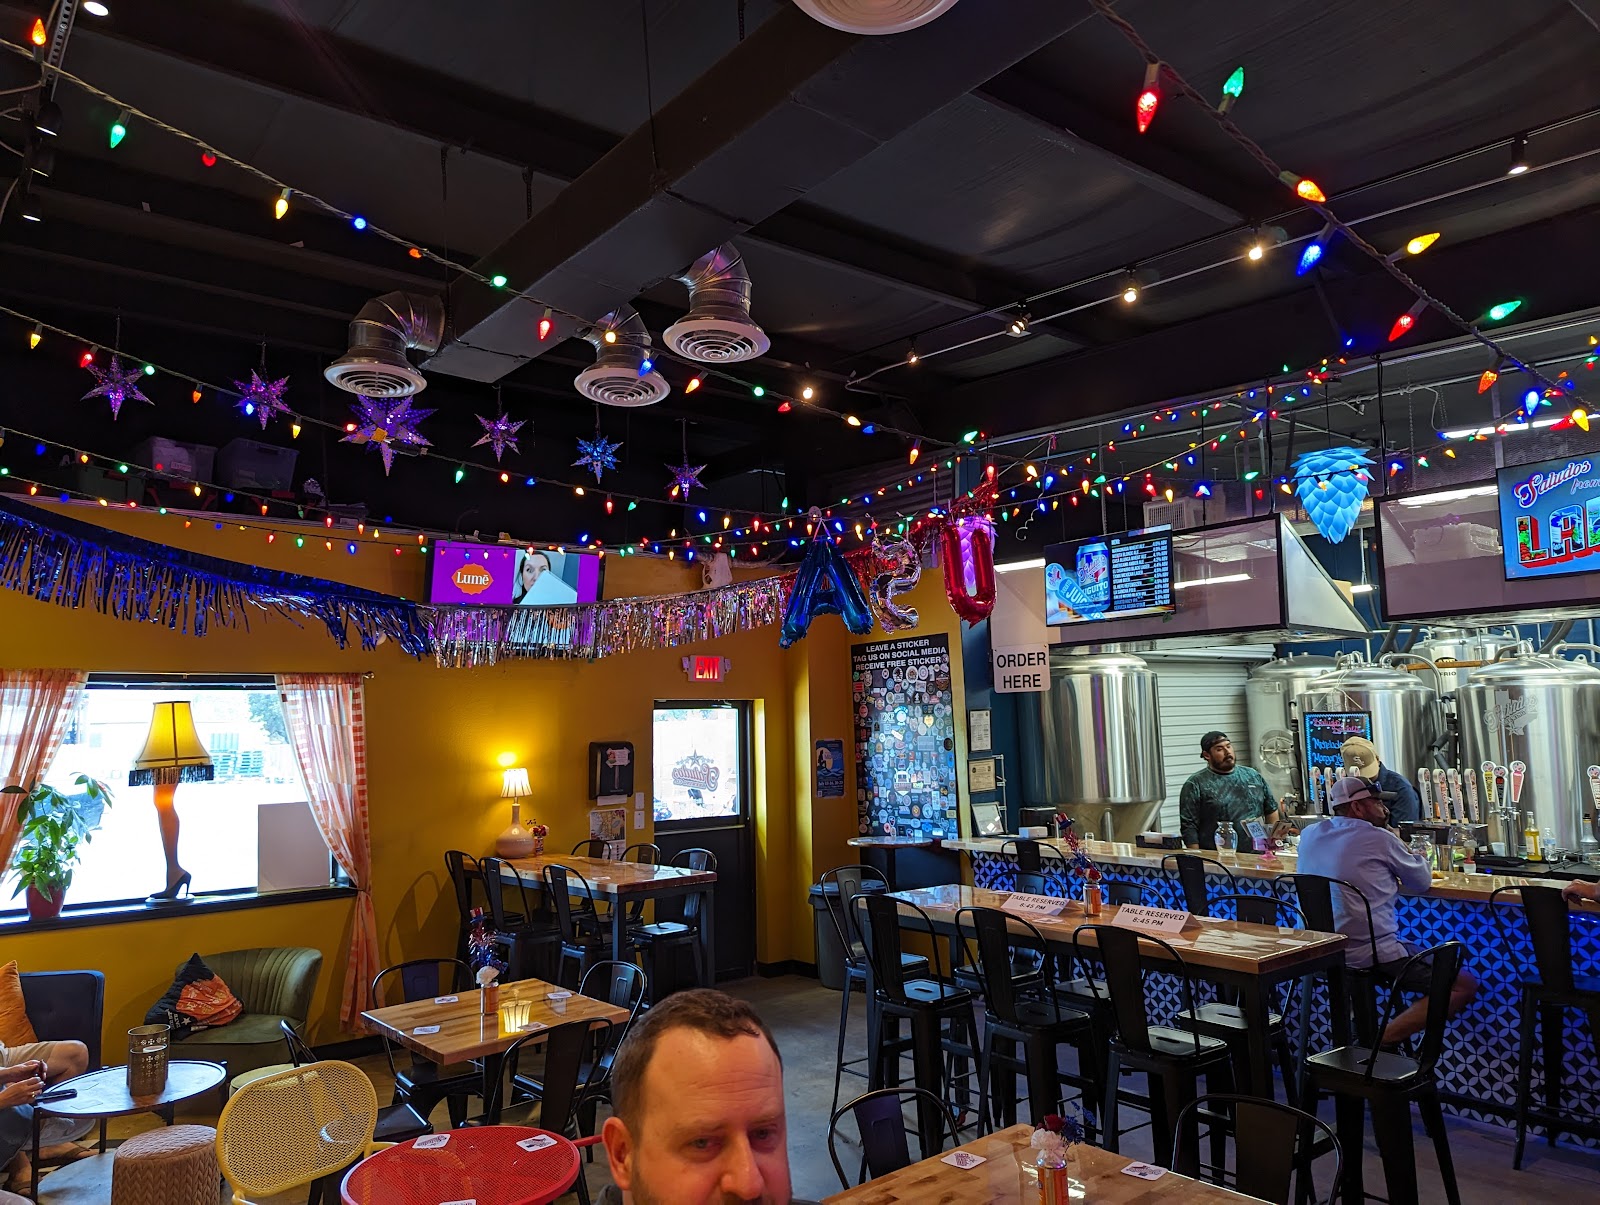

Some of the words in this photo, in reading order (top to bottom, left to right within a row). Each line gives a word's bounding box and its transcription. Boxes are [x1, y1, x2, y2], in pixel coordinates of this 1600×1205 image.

[1513, 461, 1591, 508] Saludos
[1082, 581, 1109, 596] UGUITO
[866, 644, 889, 653] LEAVE
[897, 639, 929, 649] STICKER
[891, 649, 920, 659] SOCIAL
[921, 647, 947, 656] MEDIA
[855, 662, 885, 671] RECEIVE
[887, 660, 906, 668] FREE
[997, 652, 1046, 669] ORDER
[695, 657, 720, 680] EXIT
[1003, 674, 1042, 689] HERE
[1011, 894, 1030, 903] TABLE
[1031, 897, 1065, 907] RESERVED
[1121, 906, 1144, 917] TABLE
[1145, 910, 1185, 921] RESERVED
[1151, 919, 1164, 927] PM
